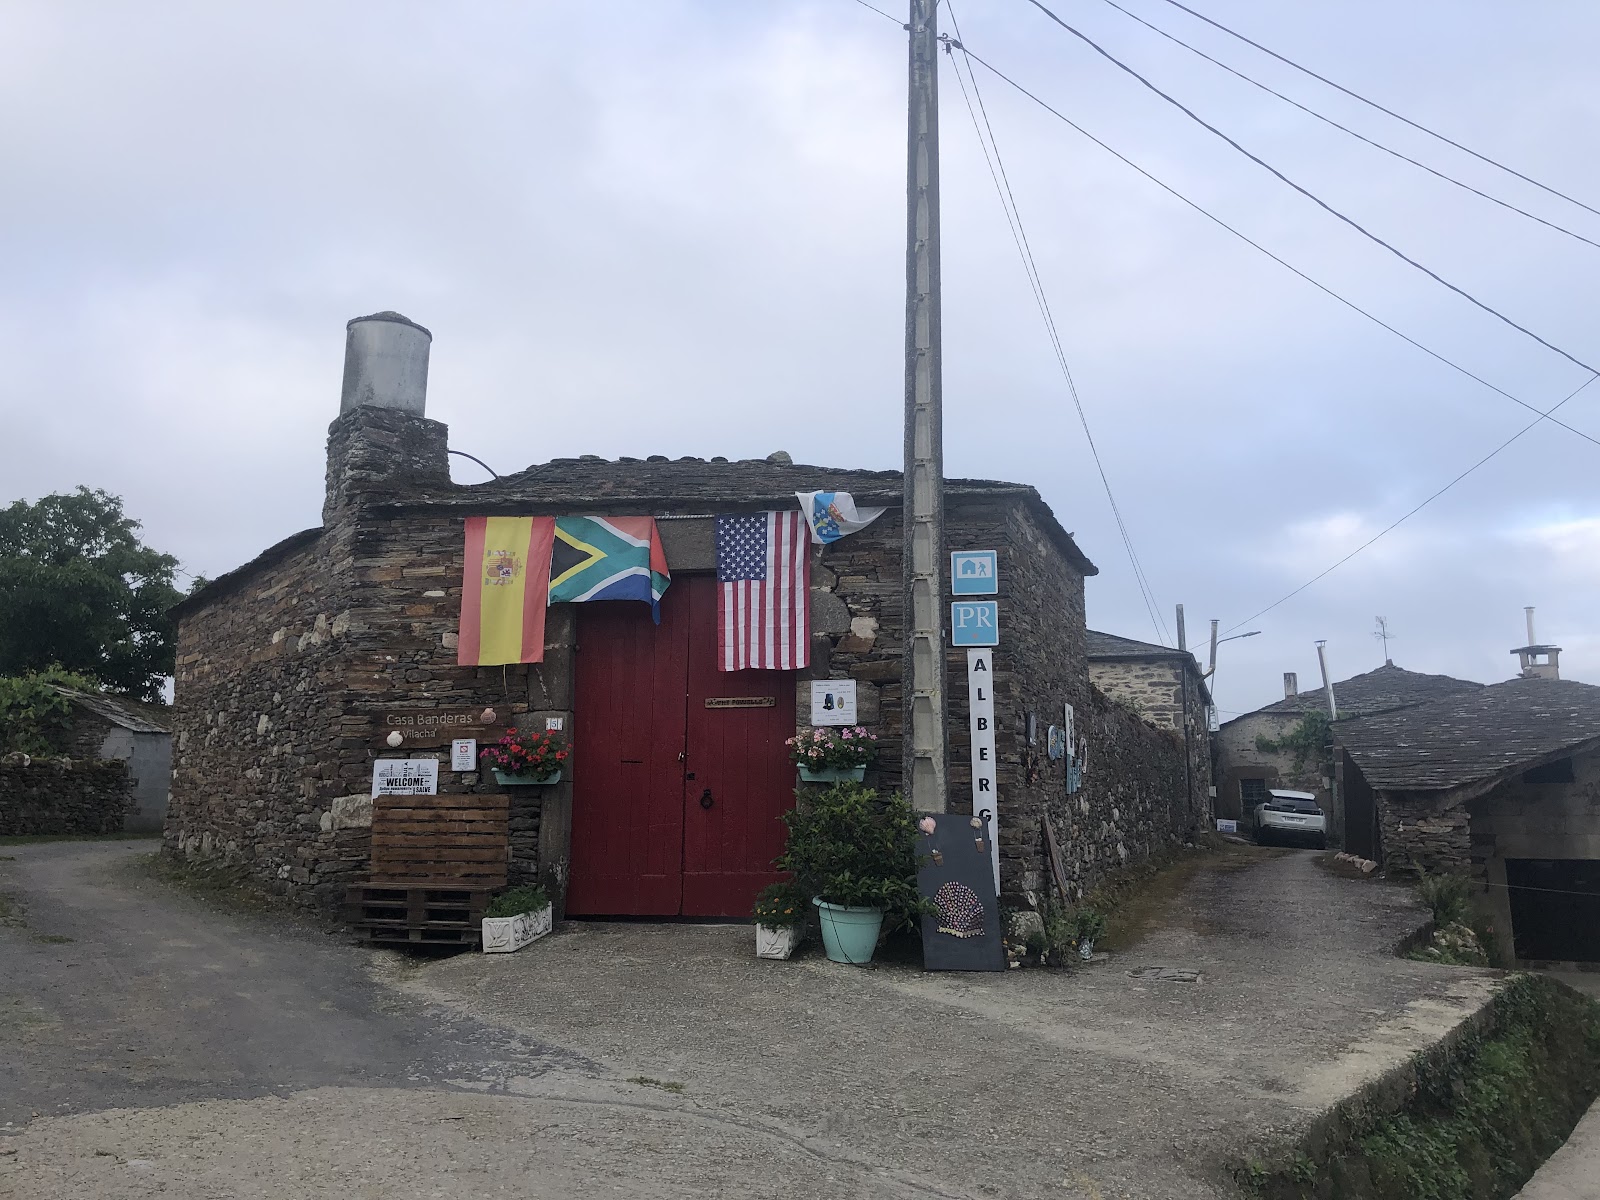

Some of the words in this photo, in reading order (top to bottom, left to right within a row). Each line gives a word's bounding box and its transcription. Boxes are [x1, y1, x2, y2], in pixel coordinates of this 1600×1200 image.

[956, 606, 993, 628] PR
[386, 714, 414, 726] Casa
[417, 712, 473, 725] Banderas
[386, 777, 424, 787] WELCOME
